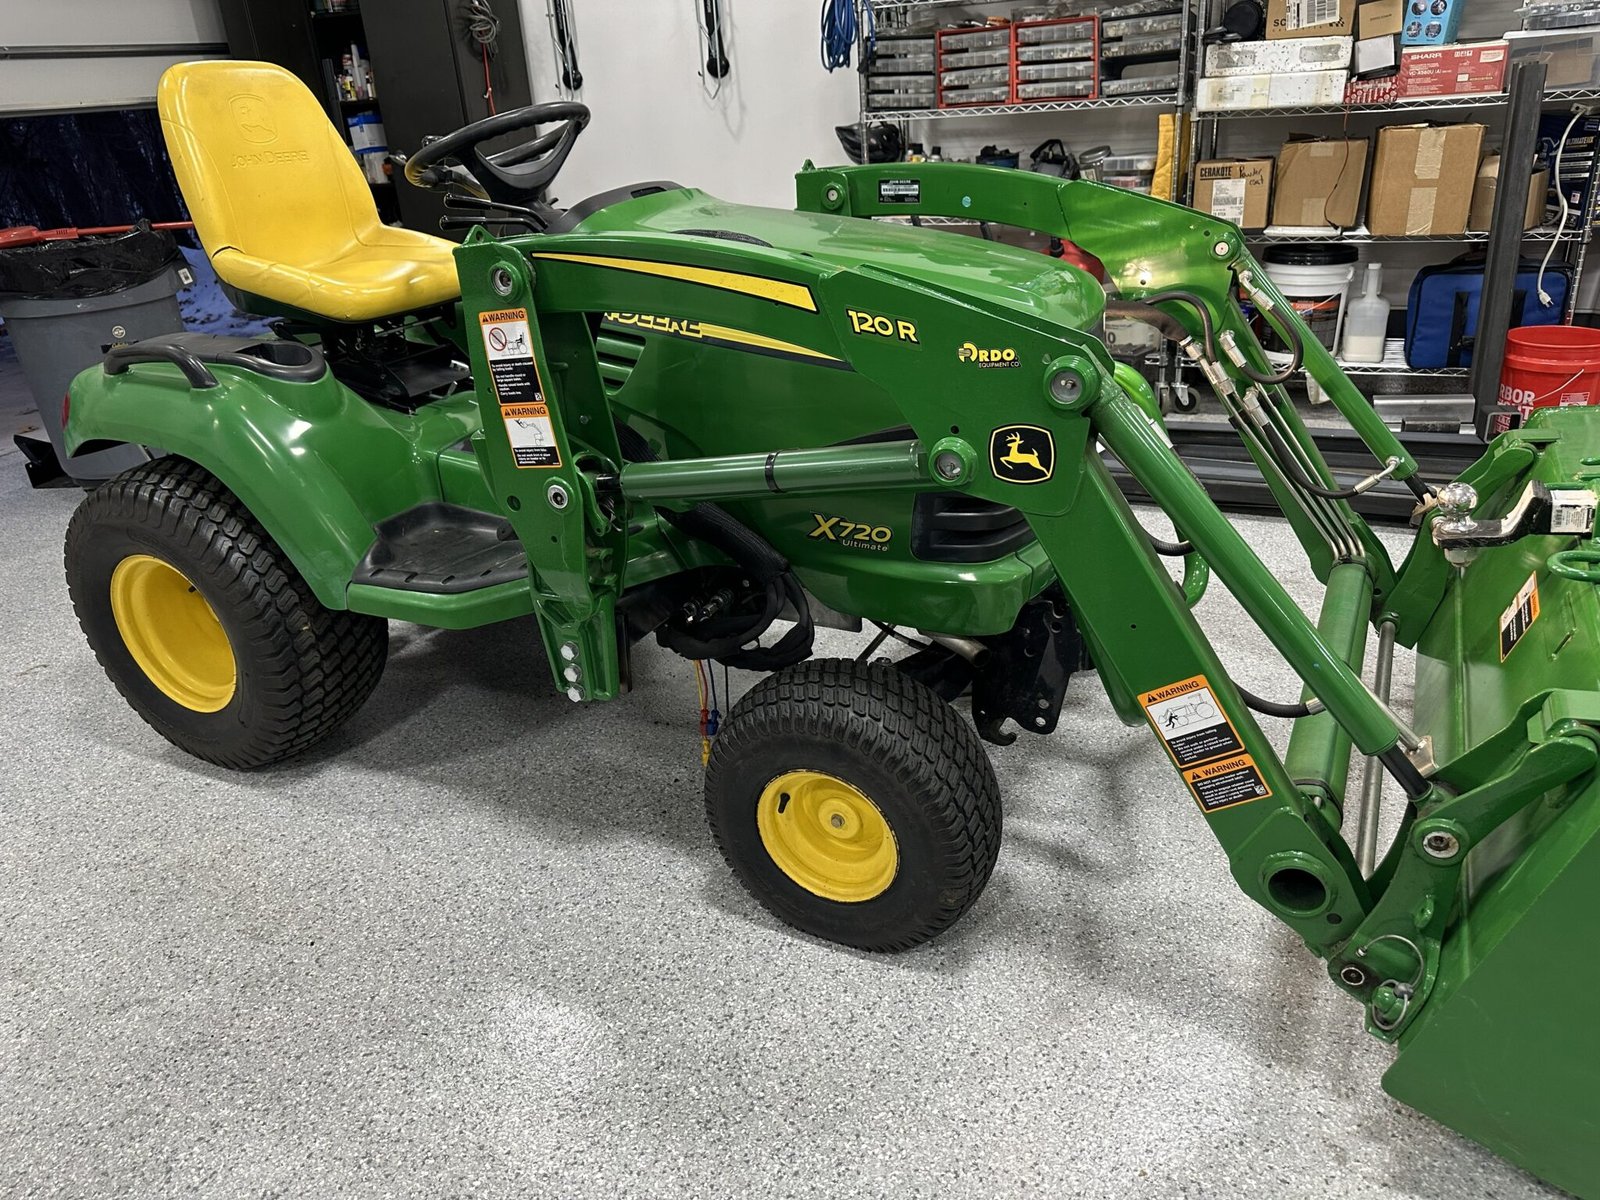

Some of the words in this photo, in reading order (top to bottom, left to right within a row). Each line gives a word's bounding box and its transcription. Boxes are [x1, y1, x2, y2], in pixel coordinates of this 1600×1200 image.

[1200, 166, 1232, 177] CERAKOTE
[488, 310, 524, 322] WARNING
[848, 310, 894, 336] 120
[897, 320, 918, 342] R
[1499, 384, 1535, 406] RBOR
[510, 407, 546, 416] WARNING
[809, 514, 891, 542] X720
[842, 540, 888, 552] Ultimate
[1156, 680, 1200, 699] WARNING
[1202, 759, 1246, 776] WARNING
